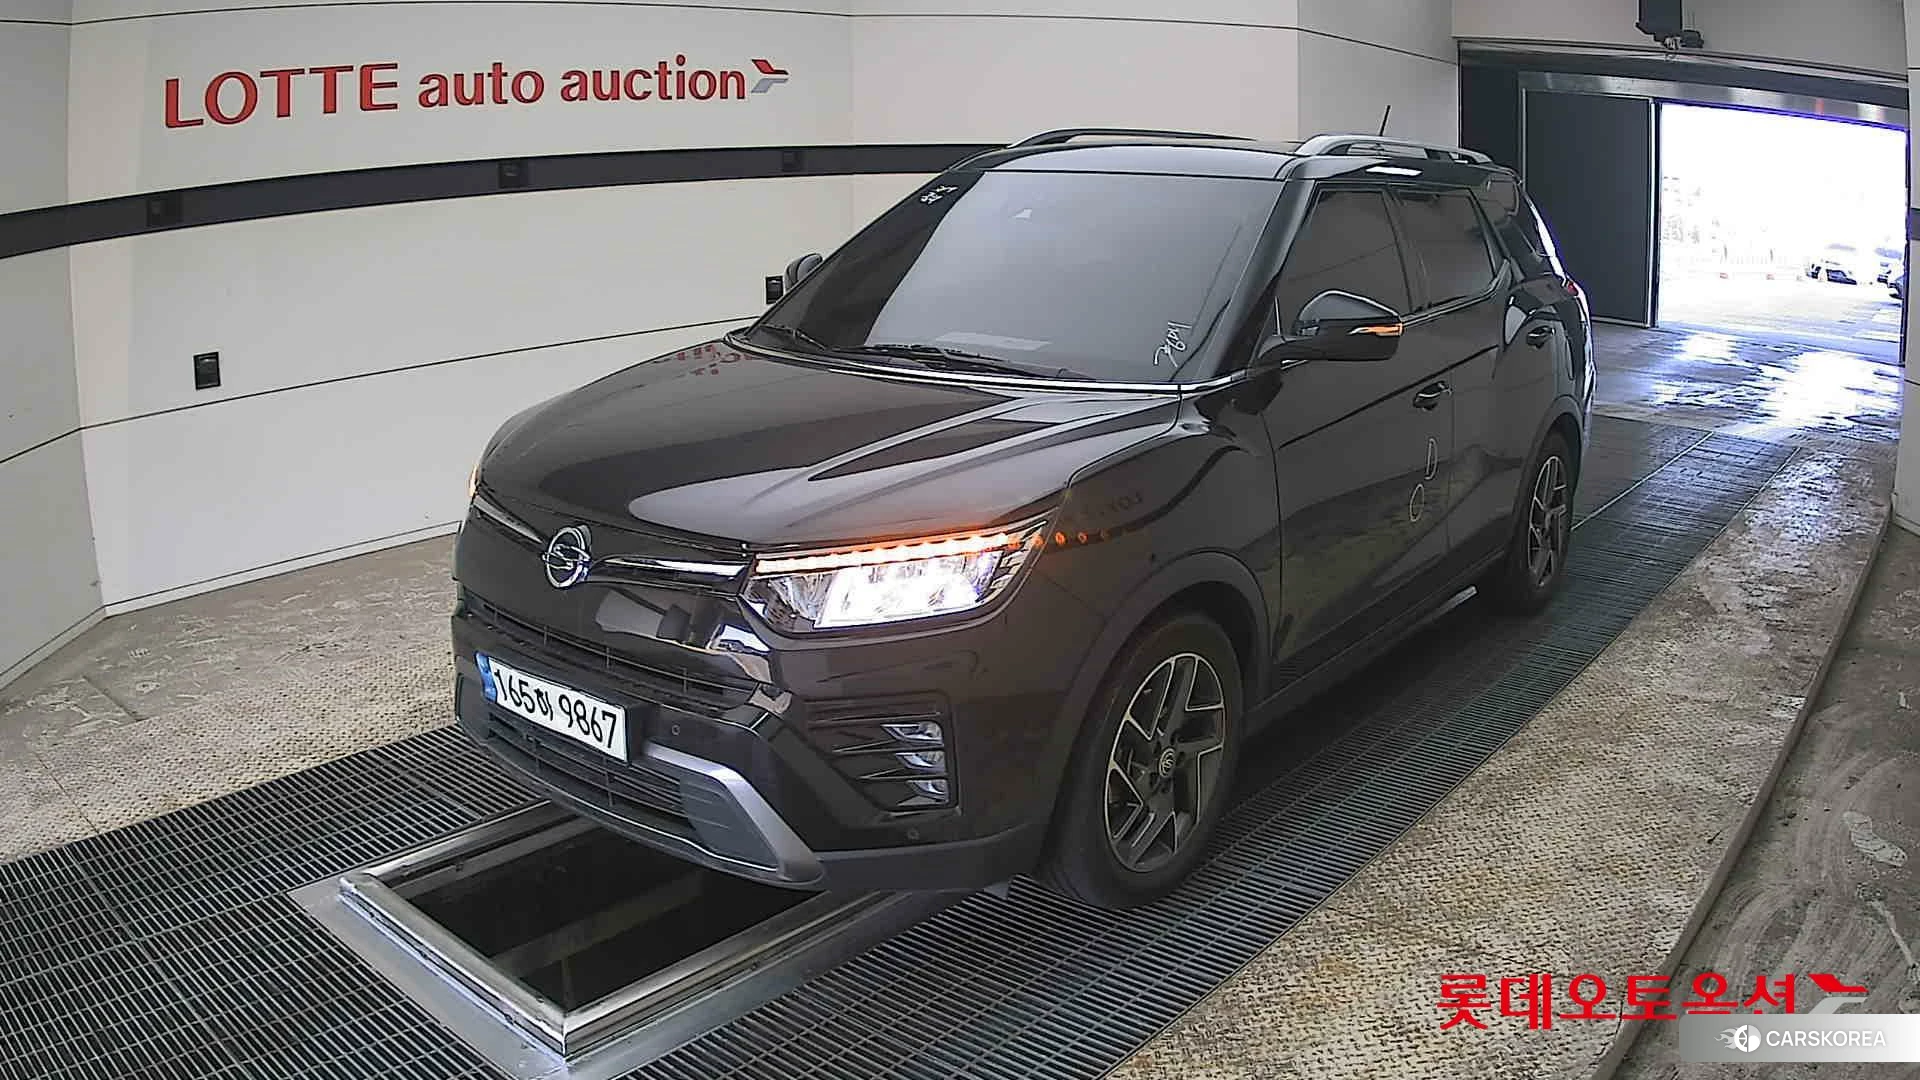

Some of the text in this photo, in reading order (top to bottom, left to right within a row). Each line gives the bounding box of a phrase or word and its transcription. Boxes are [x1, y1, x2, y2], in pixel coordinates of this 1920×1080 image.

[164, 55, 746, 129] LOTTE auto auction
[558, 694, 617, 749] 9867
